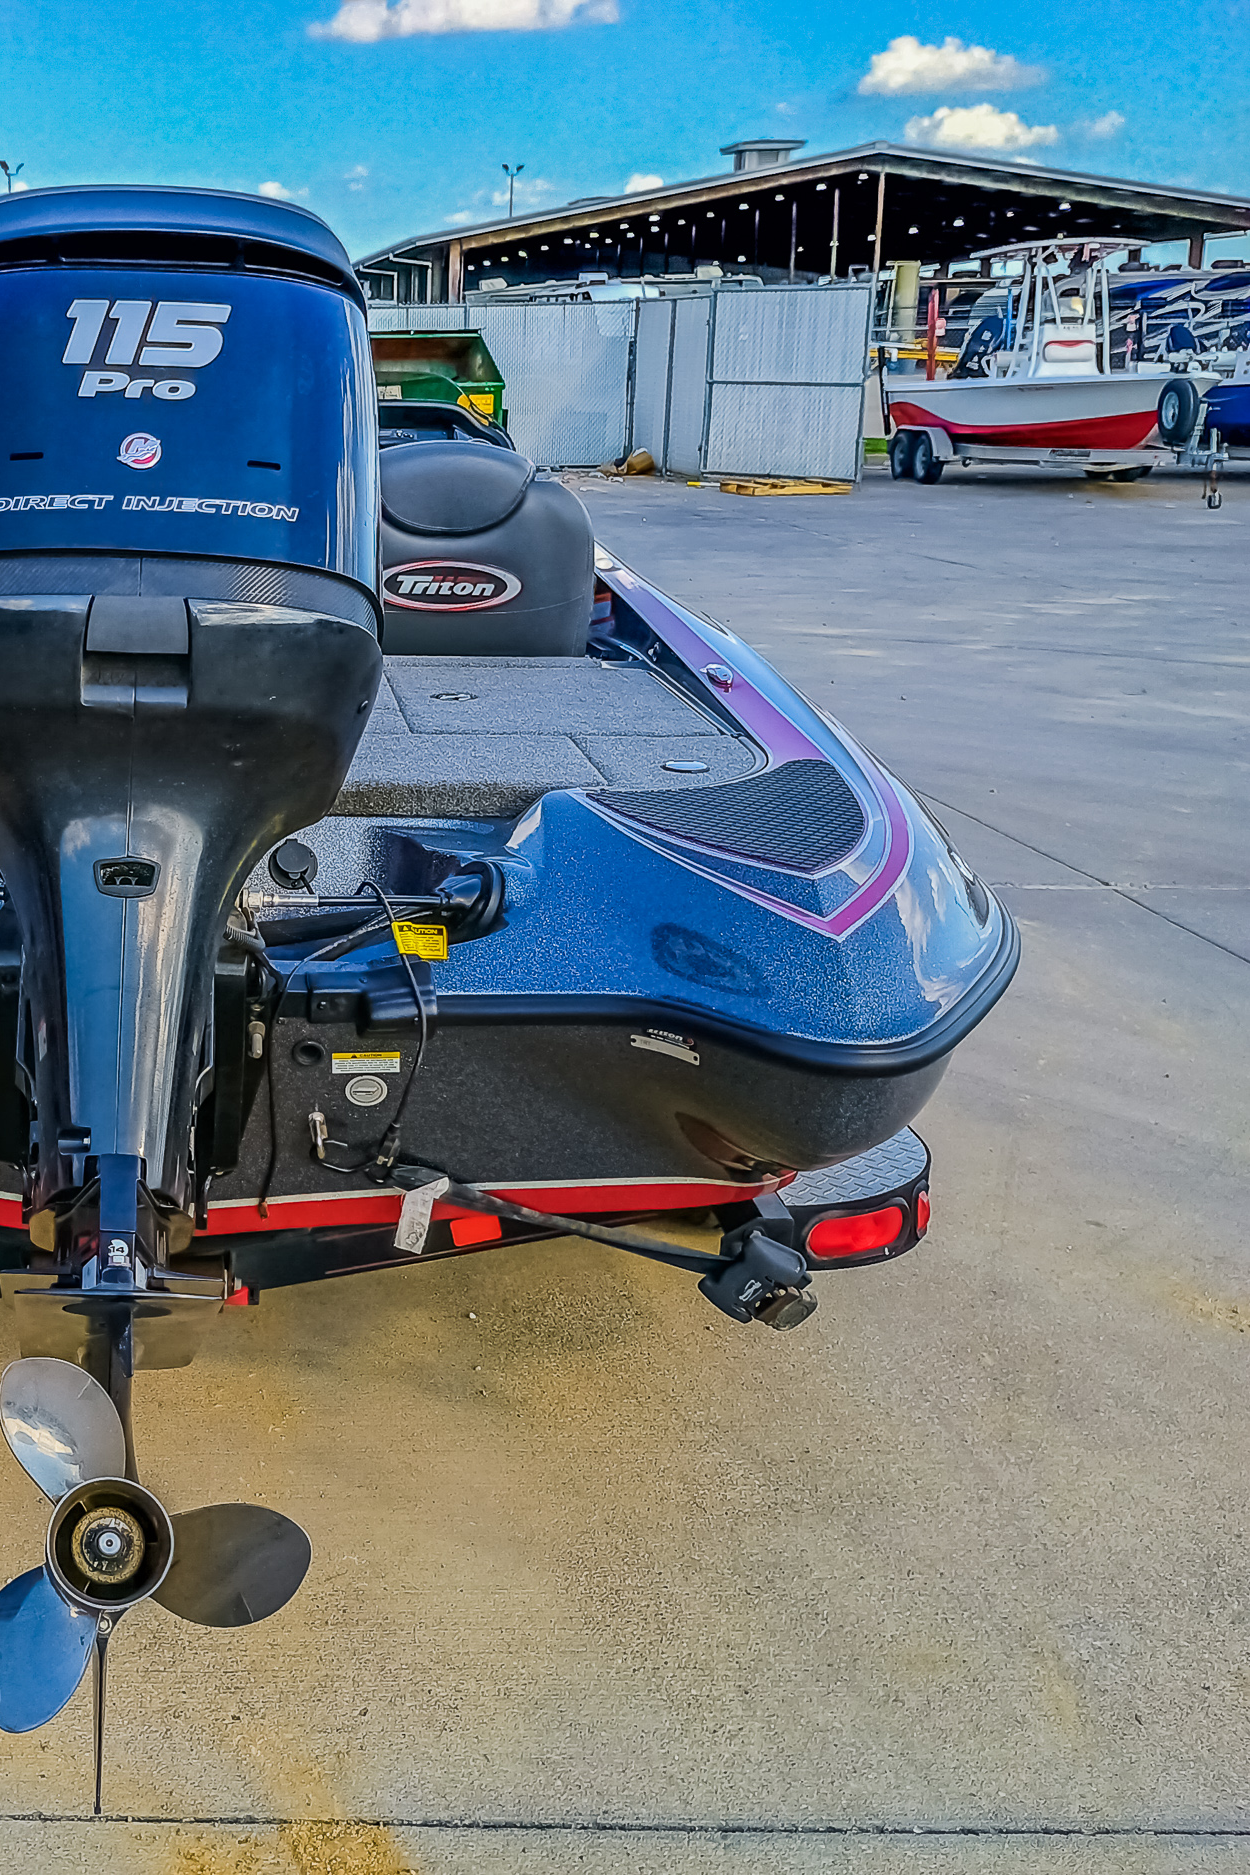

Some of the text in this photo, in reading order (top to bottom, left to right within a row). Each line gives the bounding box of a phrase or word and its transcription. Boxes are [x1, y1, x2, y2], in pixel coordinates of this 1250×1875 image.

[61, 298, 232, 369] 115
[77, 370, 197, 400] Pro
[121, 495, 300, 522] INJECTION
[396, 575, 496, 597] Triton
